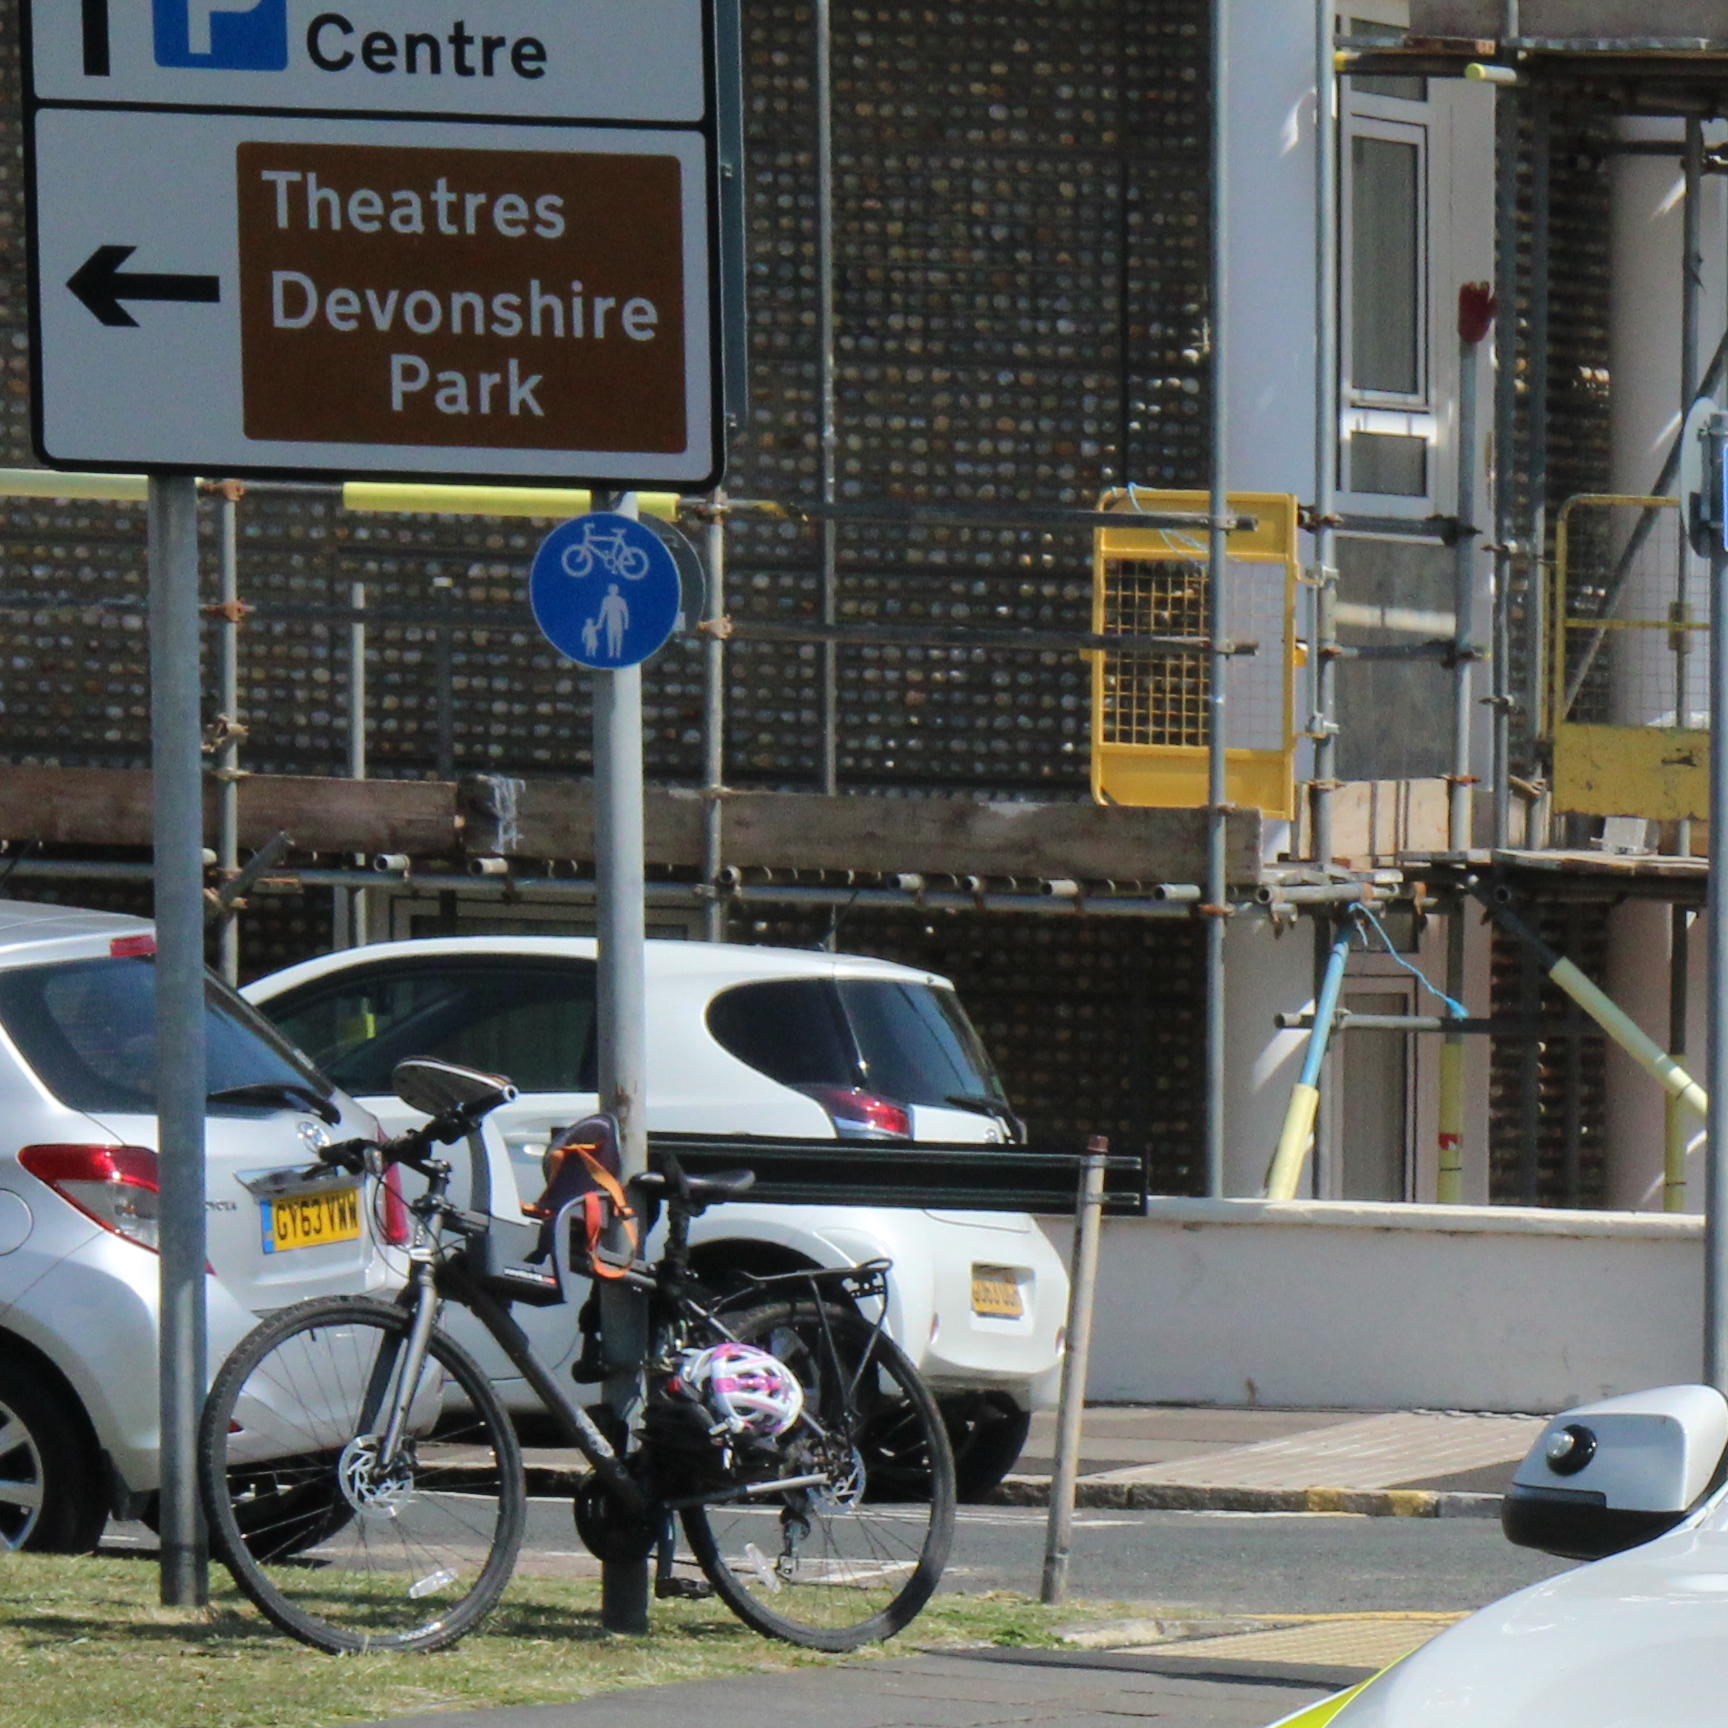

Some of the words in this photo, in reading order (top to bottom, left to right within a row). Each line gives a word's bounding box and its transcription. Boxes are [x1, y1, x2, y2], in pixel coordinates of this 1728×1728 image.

[306, 13, 547, 79] Centre
[262, 169, 567, 238] Theatres
[271, 271, 658, 343] Devonshire
[389, 354, 545, 417] Park
[276, 1199, 323, 1241] GY63
